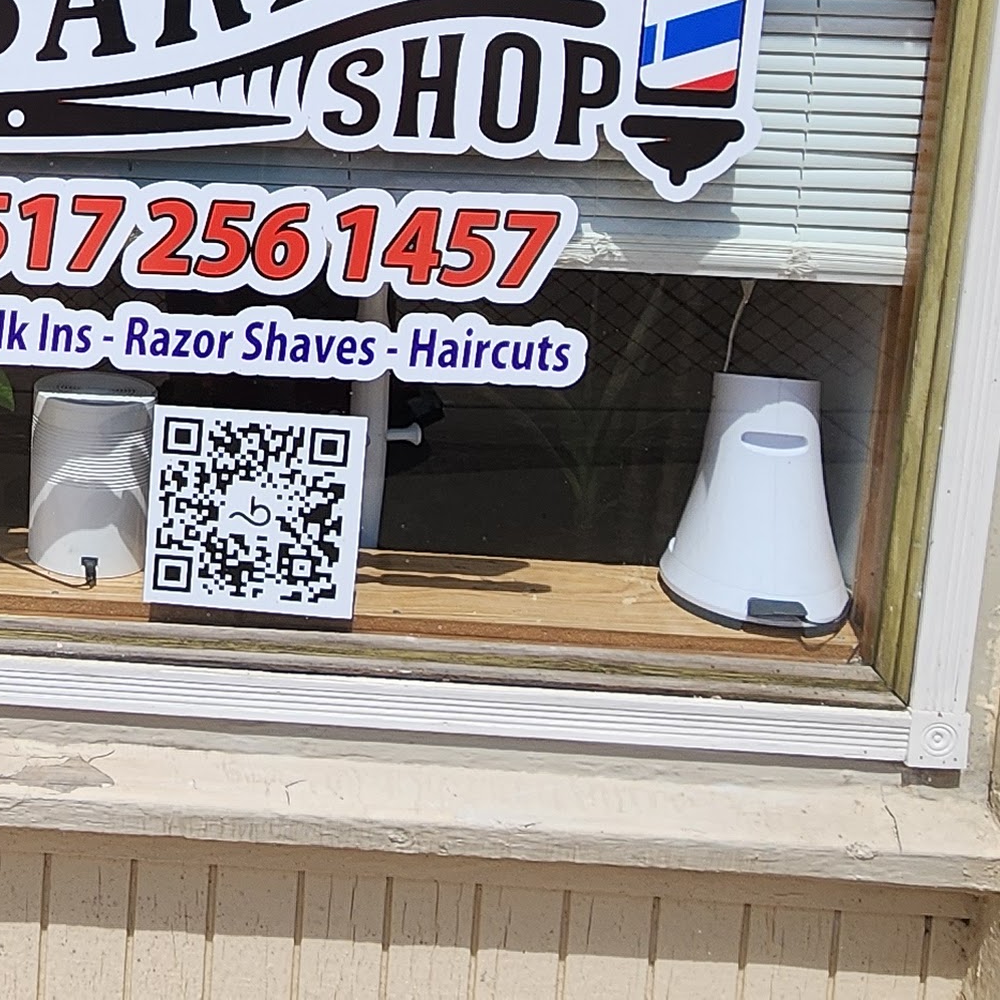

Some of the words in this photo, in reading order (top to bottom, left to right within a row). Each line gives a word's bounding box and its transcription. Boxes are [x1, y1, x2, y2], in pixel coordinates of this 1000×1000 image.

[322, 30, 622, 146] SHOP
[137, 196, 310, 280] 256
[337, 204, 561, 289] 1457
[38, 313, 92, 353] Ins
[124, 317, 235, 359] Razor
[241, 321, 376, 366] Shaves
[408, 328, 570, 372] Haircuts
